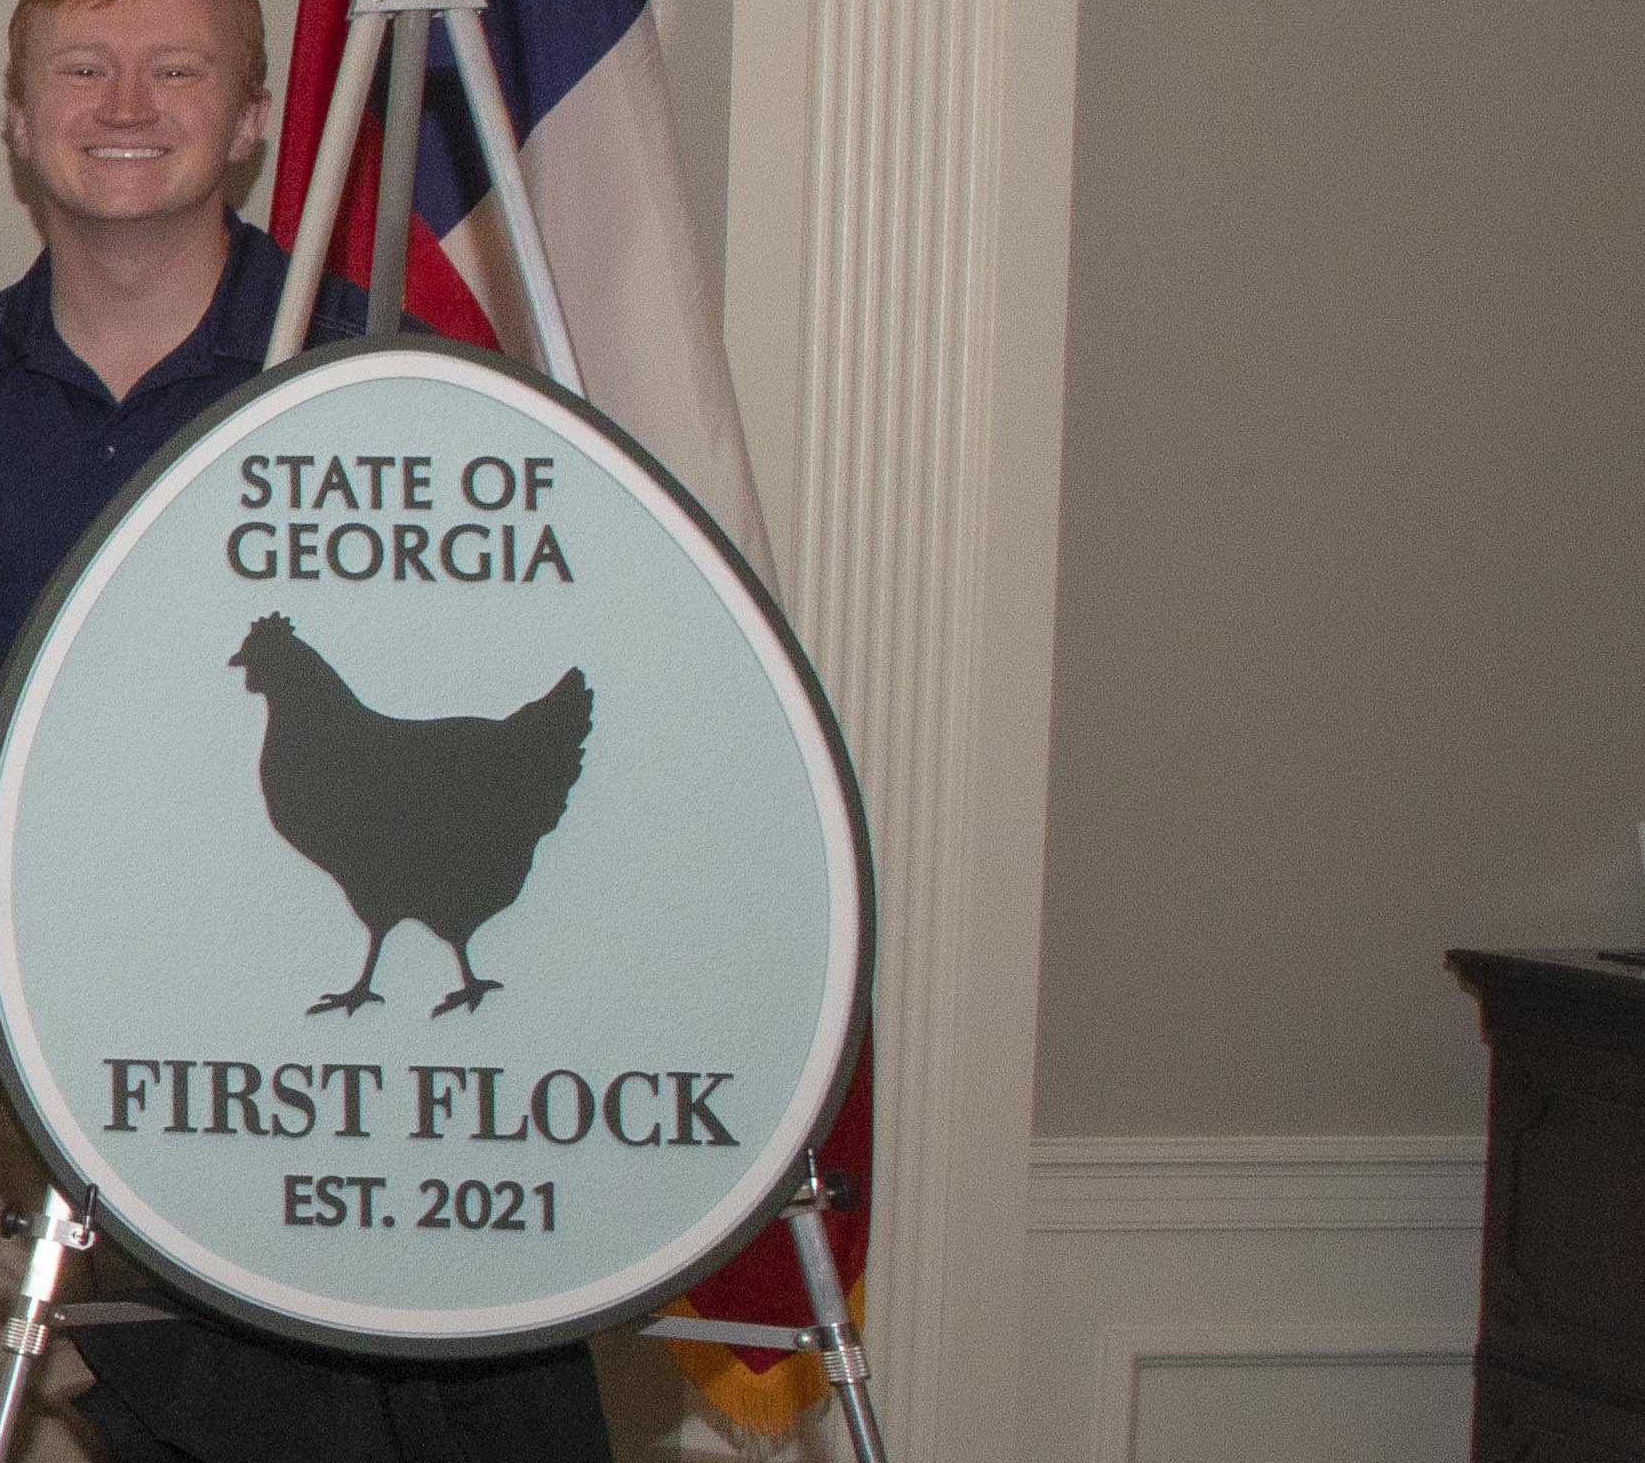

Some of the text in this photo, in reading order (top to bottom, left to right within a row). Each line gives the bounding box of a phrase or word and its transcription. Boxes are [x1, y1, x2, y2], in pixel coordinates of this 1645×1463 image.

[240, 454, 555, 512] STATE OF
[226, 521, 575, 584] GEORGIA
[103, 1058, 742, 1149] FIRST FLOCK
[284, 1174, 555, 1233] EST. 2021
